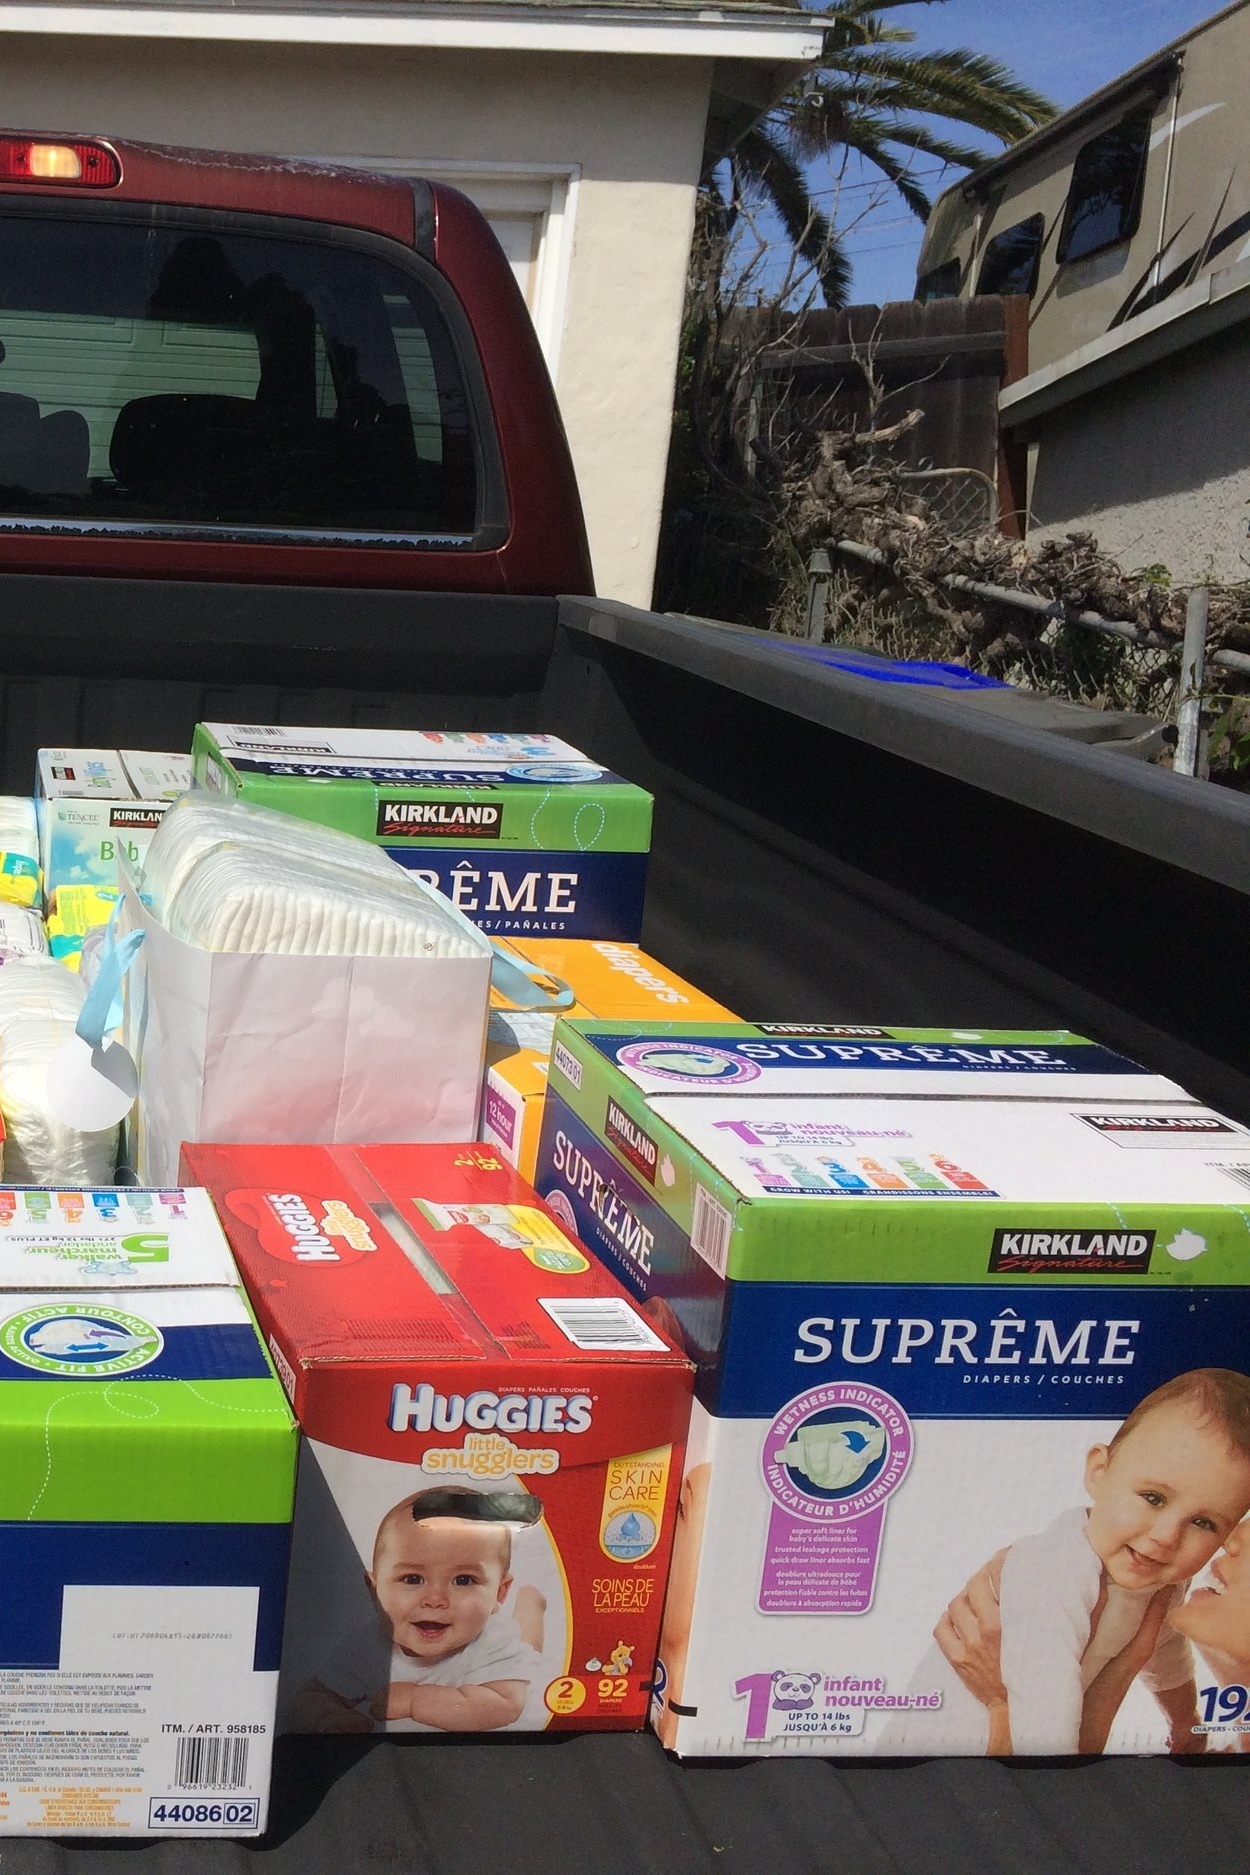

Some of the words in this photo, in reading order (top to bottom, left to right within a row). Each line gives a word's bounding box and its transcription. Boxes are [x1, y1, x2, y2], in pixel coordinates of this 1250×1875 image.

[113, 810, 165, 822] KIRKLAN
[384, 804, 498, 824] KIRKLAND
[384, 823, 496, 837] Signature
[505, 919, 566, 930] PAÑALES
[591, 942, 690, 1005] diapers
[763, 1025, 882, 1036] KIRKLAND
[736, 1038, 1067, 1065] SUPRÊME
[497, 1106, 513, 1132] hour
[1090, 1116, 1220, 1128] KIRKLAND
[609, 1105, 656, 1165] KIRKLAND
[553, 1131, 654, 1276] SUPRÊME
[268, 1193, 342, 1261] HUGGIES
[121, 1235, 169, 1263] 5
[999, 1233, 1148, 1257] KIRKLAND
[997, 1255, 1144, 1273] Signature
[622, 1258, 647, 1291] COUCHES
[21, 1307, 67, 1323] ACTIF
[76, 1307, 150, 1335] CONTOUR
[794, 1308, 1141, 1366] SUPRÊME
[55, 1364, 86, 1373] FIT
[93, 1348, 150, 1373] ACTIVE
[963, 1374, 1031, 1384] DIAPERS
[1051, 1375, 1125, 1385] COUCHES
[389, 1383, 594, 1434] HUGGIES
[774, 1389, 836, 1436] WETNESS
[839, 1388, 904, 1437] INDICATOR
[469, 1436, 505, 1451] little
[426, 1448, 555, 1475] snugglers
[610, 1470, 663, 1485] SKIN
[767, 1464, 834, 1516] INDICATEUR
[839, 1450, 906, 1515] D'HUMIDITÉ
[609, 1486, 660, 1500] CARE
[592, 1579, 633, 1593] SOINS
[636, 1579, 655, 1593] DE
[593, 1593, 613, 1607] LA
[614, 1593, 650, 1607] PEAU
[558, 1681, 574, 1699] 2
[597, 1679, 629, 1697] 92
[735, 1673, 774, 1739] 1
[823, 1676, 883, 1692] infant
[824, 1692, 940, 1707] nouveau-né
[788, 1712, 804, 1721] UP
[806, 1712, 819, 1721] TO
[822, 1712, 833, 1720] 14
[835, 1712, 850, 1721] lbs
[161, 1724, 186, 1733] ITM.
[196, 1724, 223, 1734] ART.
[227, 1725, 266, 1734] 958185
[783, 1722, 828, 1732] JUSQU'À
[830, 1723, 837, 1731] 6
[839, 1723, 852, 1733] kg
[153, 1805, 222, 1822] 44086
[226, 1805, 254, 1822] 02
